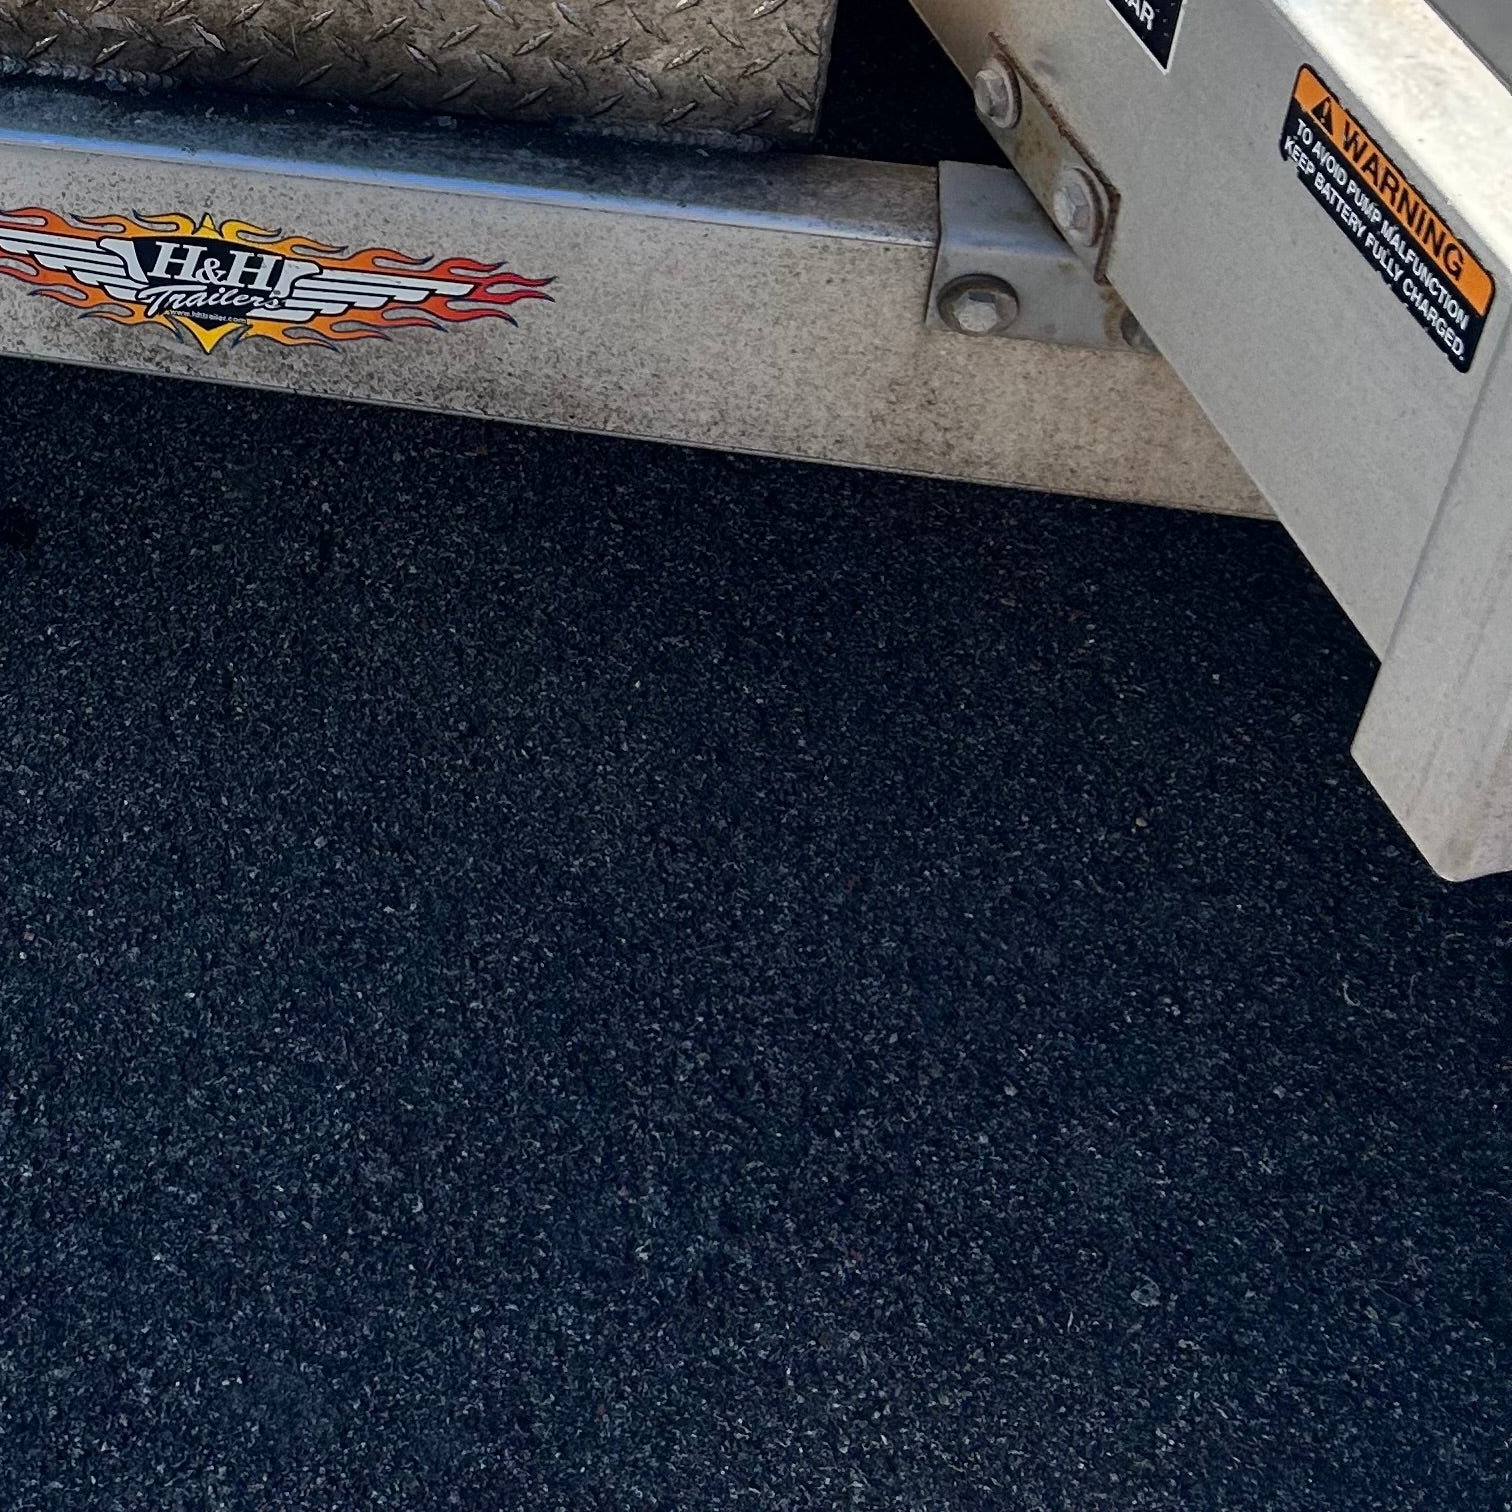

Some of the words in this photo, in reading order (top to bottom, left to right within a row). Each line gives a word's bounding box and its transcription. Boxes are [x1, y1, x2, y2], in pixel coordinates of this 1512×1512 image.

[146, 240, 283, 292] H&H
[1284, 135, 1316, 175] KEEP
[1314, 171, 1367, 237] BATTERY
[1364, 232, 1405, 282] FULLY
[1402, 278, 1465, 361] CHARGED.
[1296, 118, 1313, 145] TO
[1311, 140, 1348, 187] AVOID
[1346, 180, 1382, 223] PUMP
[1381, 218, 1469, 331] MALFUNCTION
[1342, 120, 1465, 282] WARNING
[137, 284, 282, 317] Trailers
